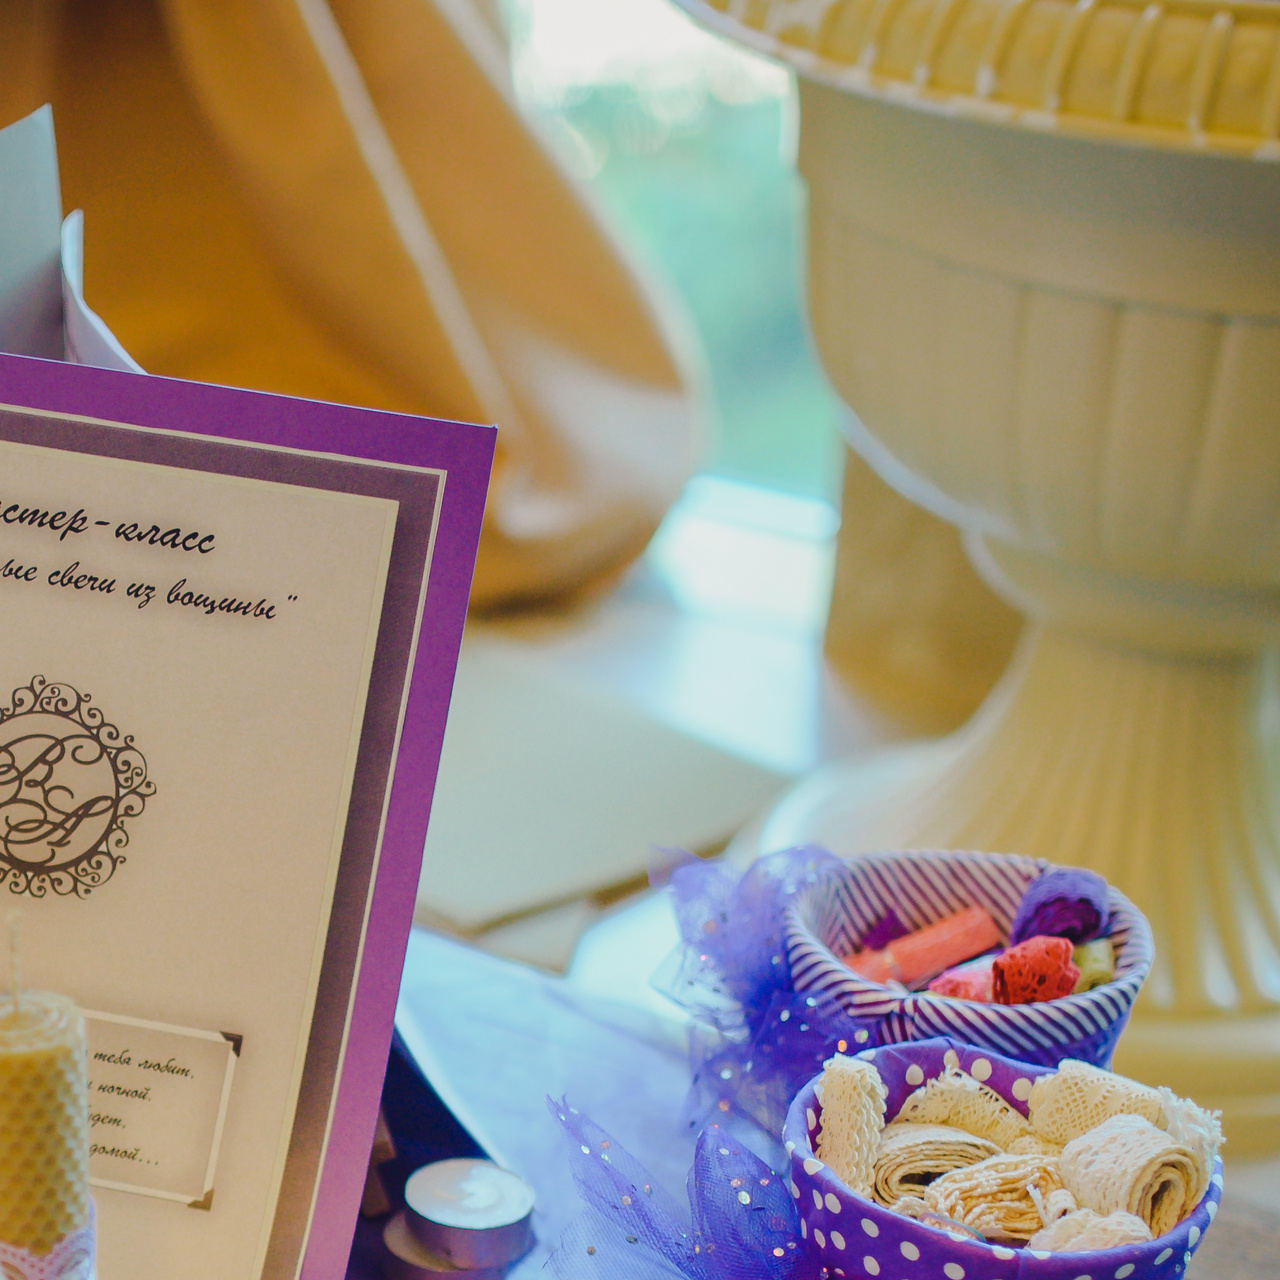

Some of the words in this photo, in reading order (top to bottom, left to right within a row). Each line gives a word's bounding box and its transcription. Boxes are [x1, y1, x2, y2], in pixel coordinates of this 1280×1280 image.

[47, 561, 116, 594] свечи
[126, 581, 157, 610] из
[93, 1049, 131, 1066] тебя
